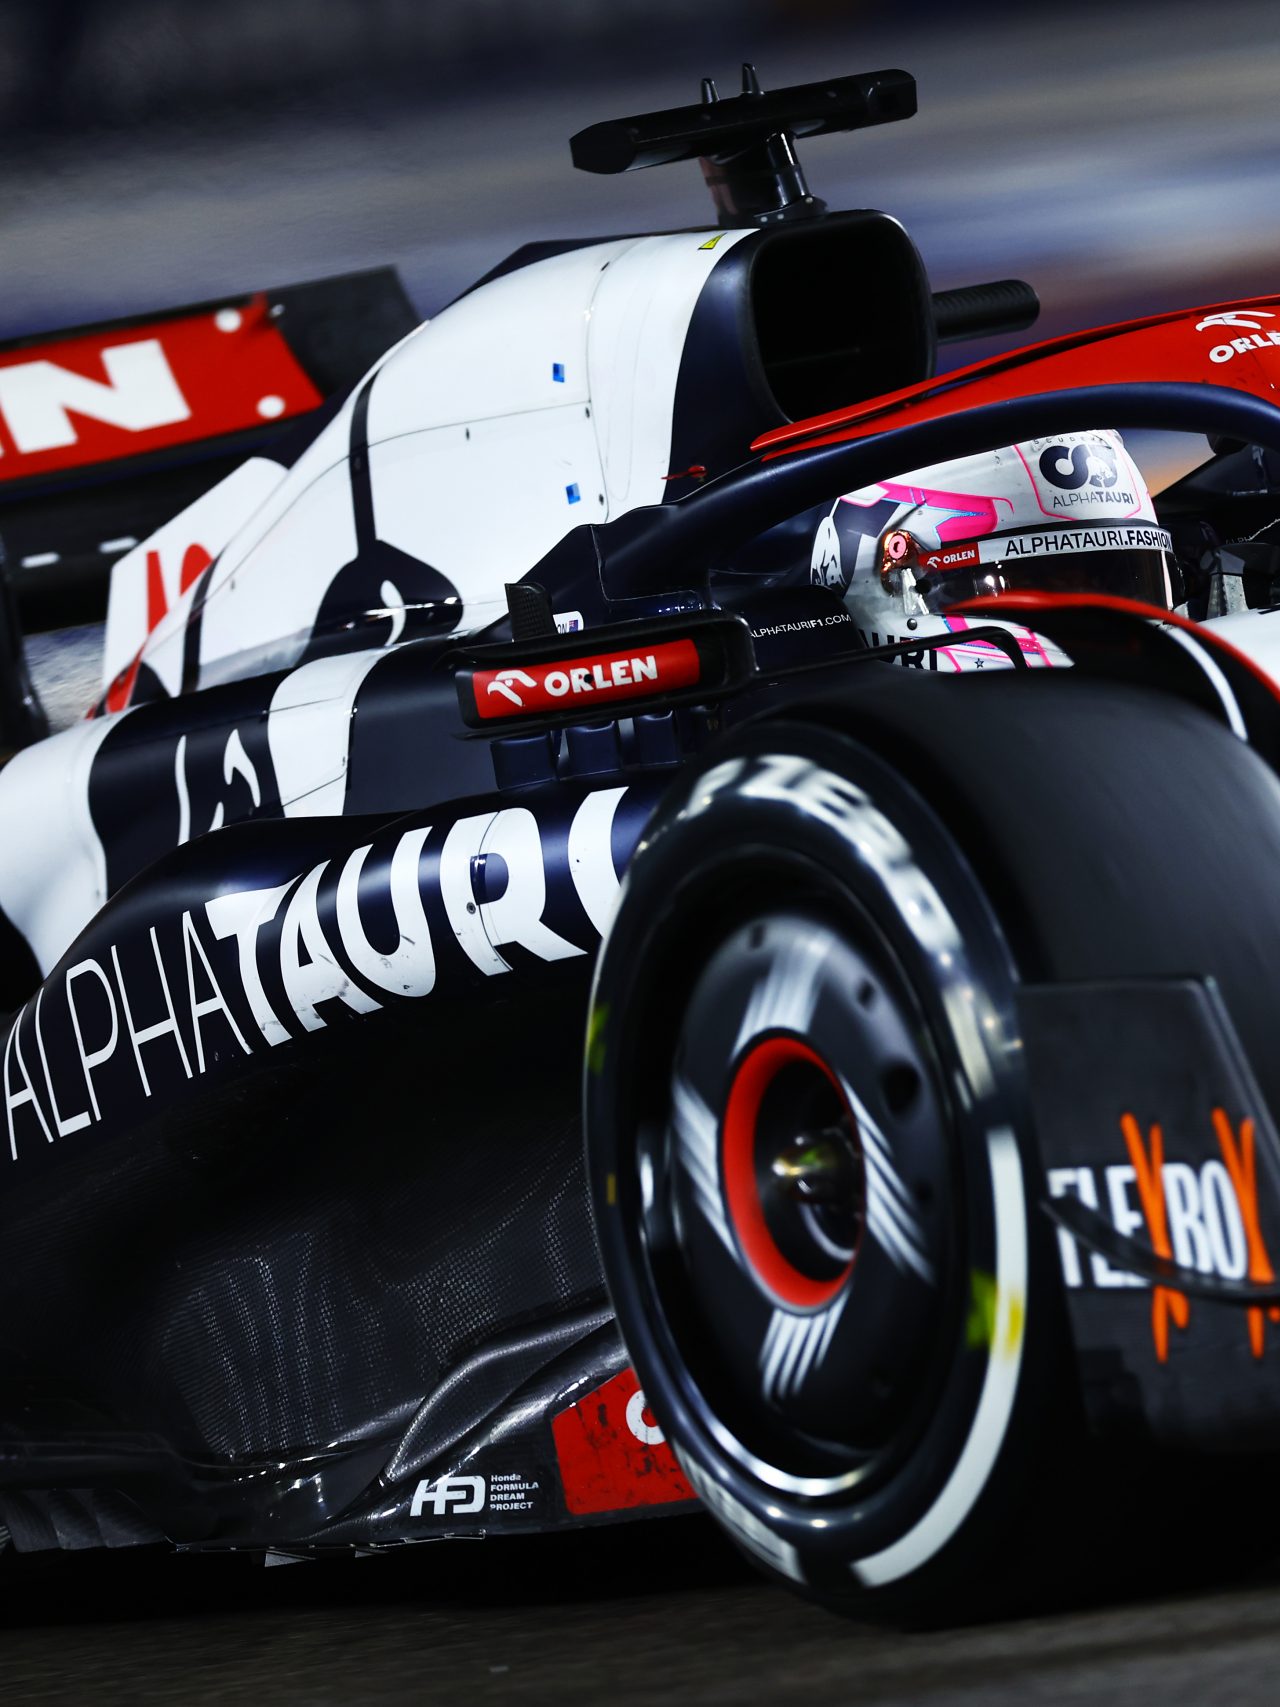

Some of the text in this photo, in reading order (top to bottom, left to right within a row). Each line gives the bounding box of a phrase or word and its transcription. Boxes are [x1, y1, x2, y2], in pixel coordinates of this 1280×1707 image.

[1053, 491, 1134, 509] ALPHATAURI
[1005, 529, 1171, 557] ALPHATAURI.FASHION
[943, 550, 975, 564] ORLEN
[544, 655, 658, 697] ORLEN
[491, 1474, 522, 1482] Honda
[490, 1482, 539, 1491] FORMULA
[490, 1493, 525, 1501] DREAM
[490, 1502, 534, 1511] PROJECT
